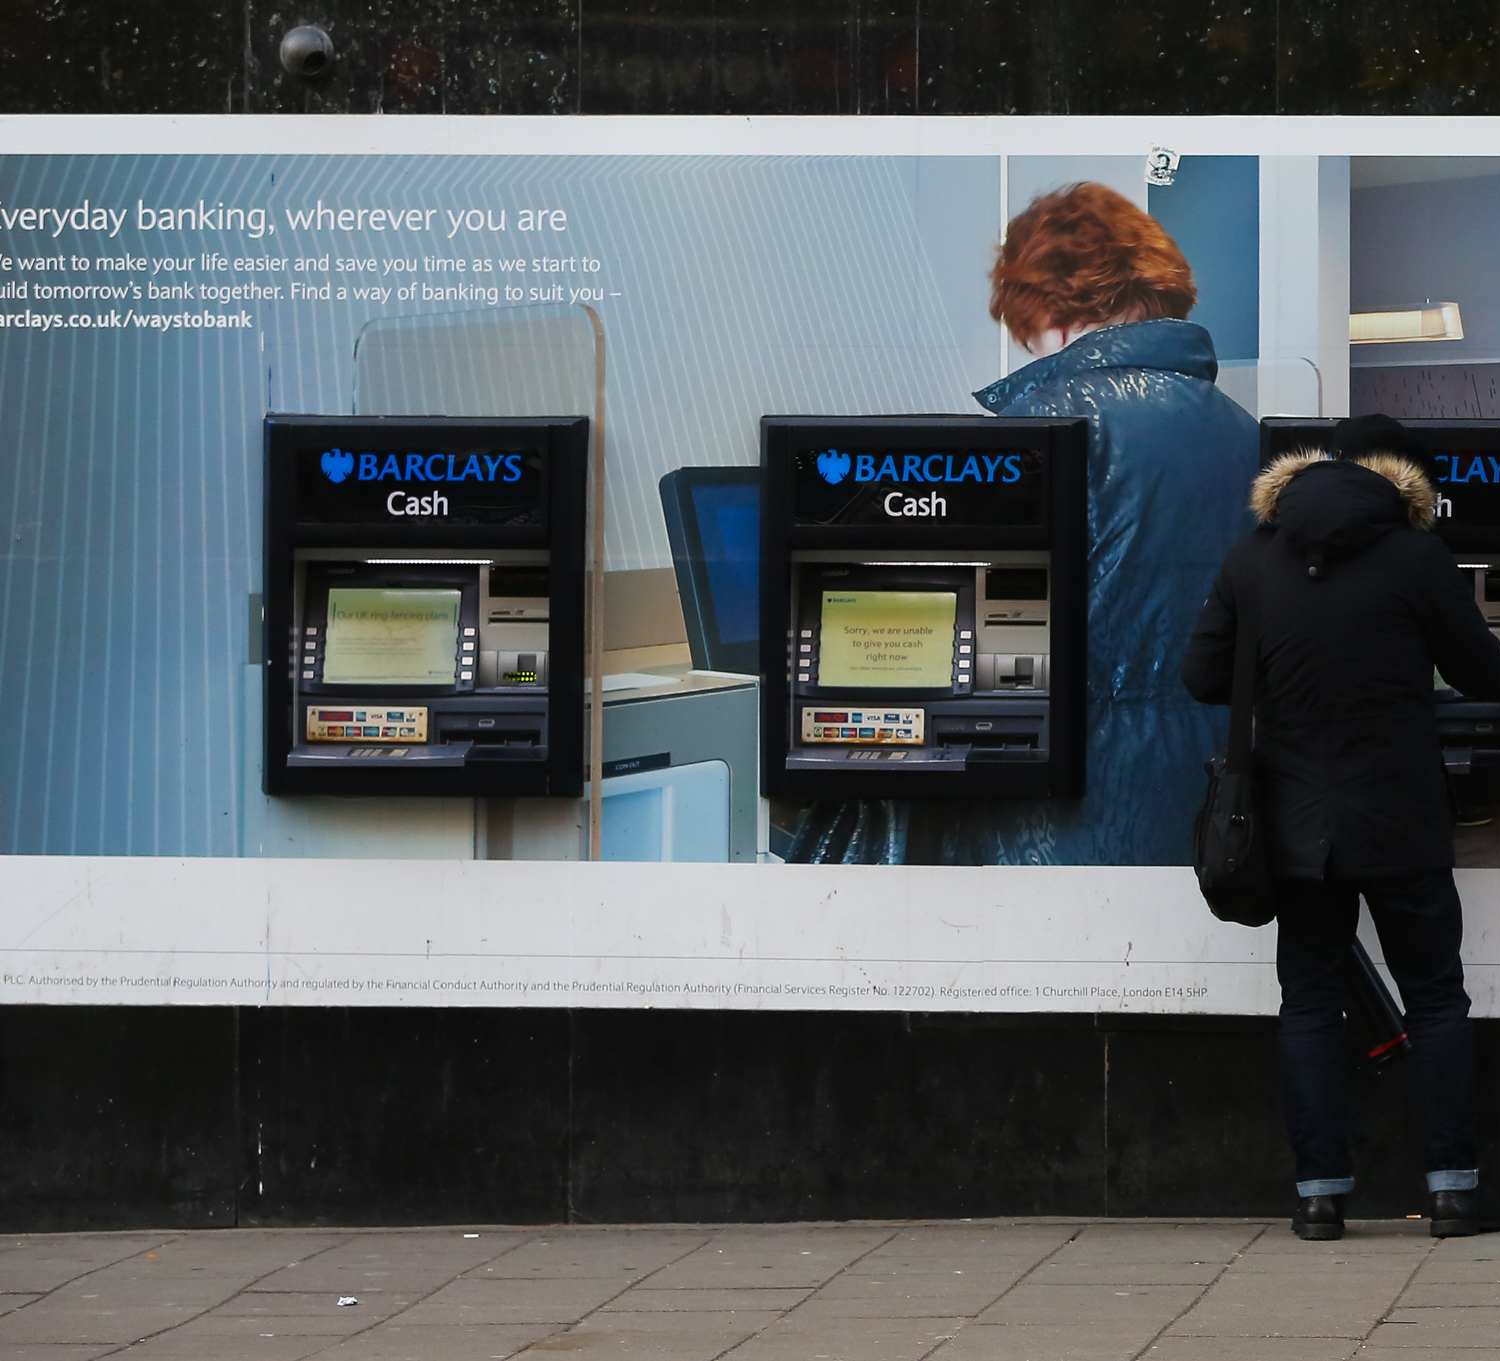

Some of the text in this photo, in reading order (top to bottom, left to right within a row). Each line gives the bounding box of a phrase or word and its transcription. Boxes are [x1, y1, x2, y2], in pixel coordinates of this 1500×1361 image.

[0, 199, 566, 238] veryday banking, wherever you are
[0, 253, 600, 276] e want to make your life easier and save you time as we start to
[0, 281, 27, 299] uild
[34, 281, 142, 299] tomorrow’s
[148, 281, 194, 299] bank
[200, 281, 284, 304] together.
[291, 282, 330, 299] Find
[337, 287, 347, 300] a
[353, 287, 392, 304] way
[398, 282, 418, 300] of
[423, 283, 498, 305] banking
[505, 285, 523, 300] to
[530, 284, 563, 300] suit
[568, 281, 603, 305] you
[0, 309, 252, 332] arclays.co.uk/waystobank
[358, 454, 522, 482] BARCLAYS
[855, 455, 1021, 483] BARCLAYS
[387, 490, 448, 516] Cash
[884, 492, 947, 517] Cash
[844, 626, 869, 635] Sorry,
[864, 640, 881, 649] give
[866, 653, 886, 662] right
[4, 974, 26, 985] PLC.
[29, 975, 83, 986] Authorised
[86, 975, 98, 989] by
[101, 975, 117, 986] the
[120, 976, 172, 987] Prudential
[173, 976, 227, 990] Regulation
[230, 977, 277, 990] Authority
[280, 977, 298, 988] and
[302, 978, 349, 991] regulated
[352, 978, 364, 991] by
[367, 978, 383, 989] the
[386, 979, 430, 989] Financial
[433, 979, 477, 990] Conduct
[480, 980, 527, 993] Authority
[531, 980, 549, 991] and
[553, 980, 569, 991] the
[572, 981, 624, 991] Prudential
[627, 981, 681, 995] Regulation
[683, 982, 731, 995] Authority
[734, 982, 781, 996] (Financial
[785, 983, 826, 994] Services
[829, 983, 870, 997] Register
[893, 984, 937, 997] 122702).
[1000, 985, 1032, 996] office:
[1035, 985, 1040, 996] 1
[1043, 986, 1087, 996] Churchill
[1123, 986, 1161, 997] London
[1165, 987, 1183, 998] E14
